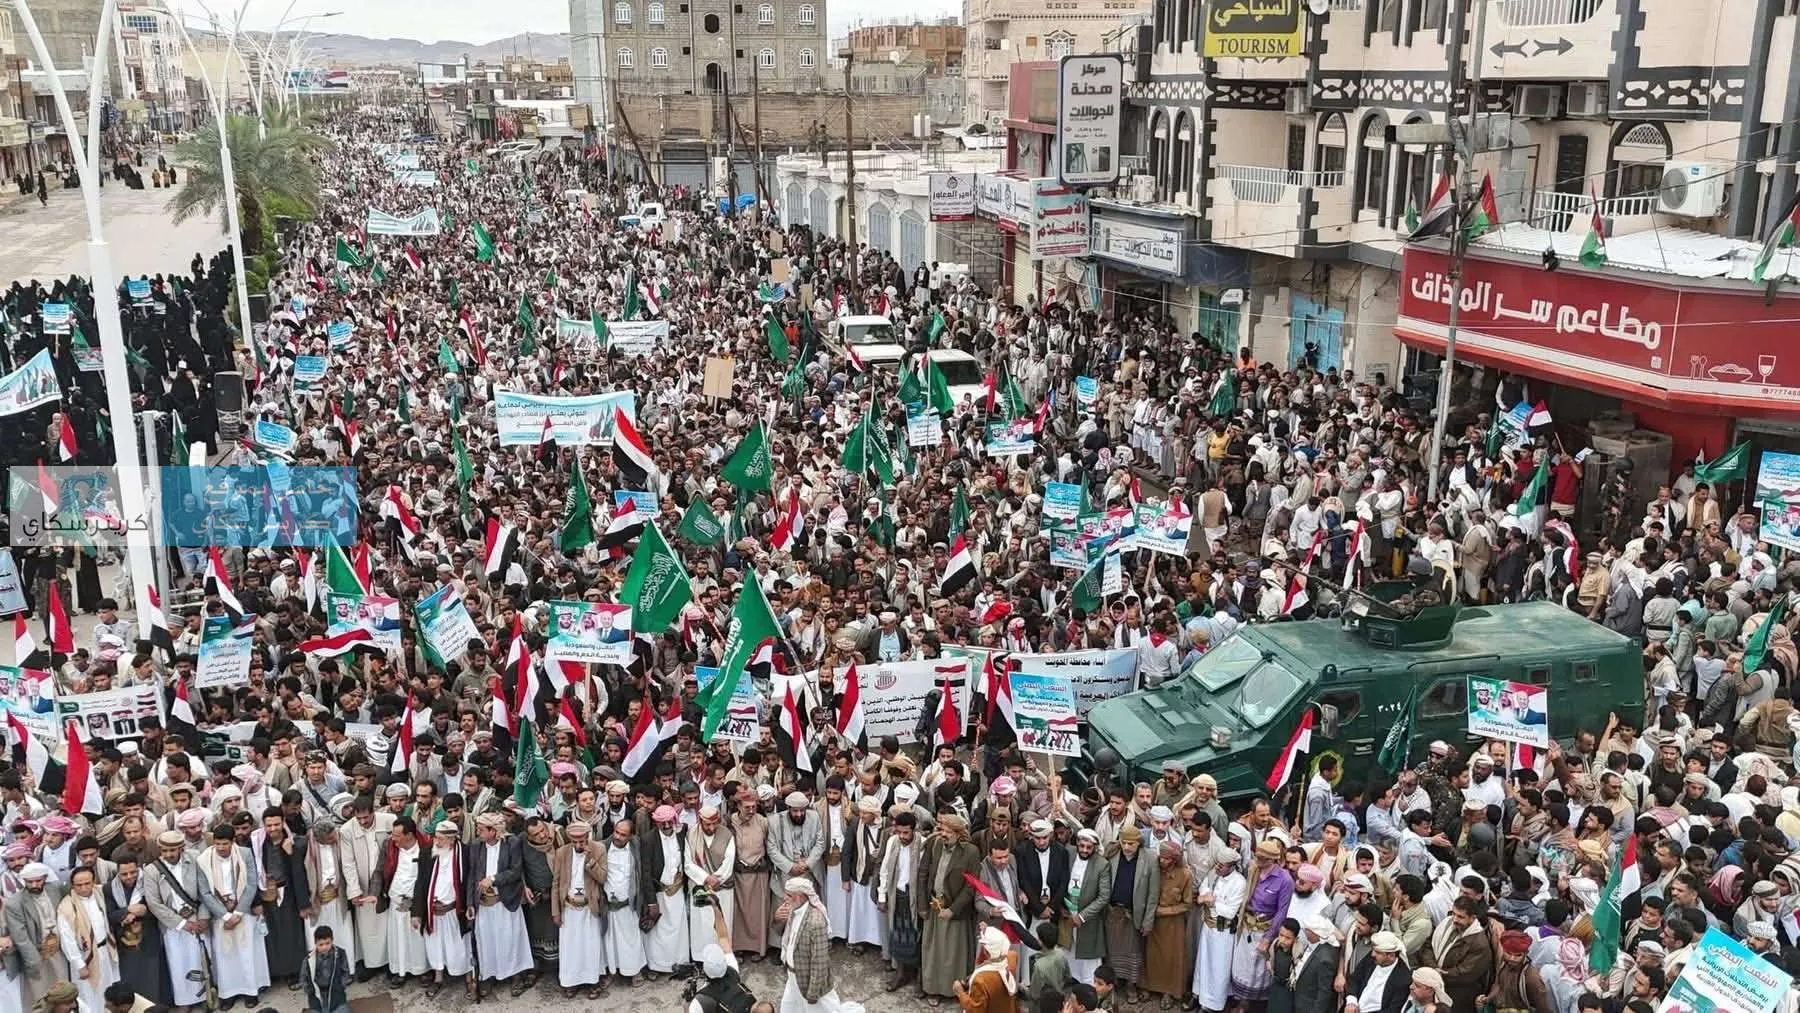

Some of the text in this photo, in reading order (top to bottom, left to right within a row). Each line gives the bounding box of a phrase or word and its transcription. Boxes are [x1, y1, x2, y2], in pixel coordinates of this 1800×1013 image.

[1219, 39, 1289, 53] TOURISM
[1082, 64, 1105, 76] مركز
[1071, 82, 1112, 95] هدنة
[1069, 104, 1114, 120] للجوالات
[1037, 220, 1087, 240] والسلام
[1411, 271, 1662, 350] مطاعم سر المذاق
[1708, 944, 1778, 988] الشعب اليمني
